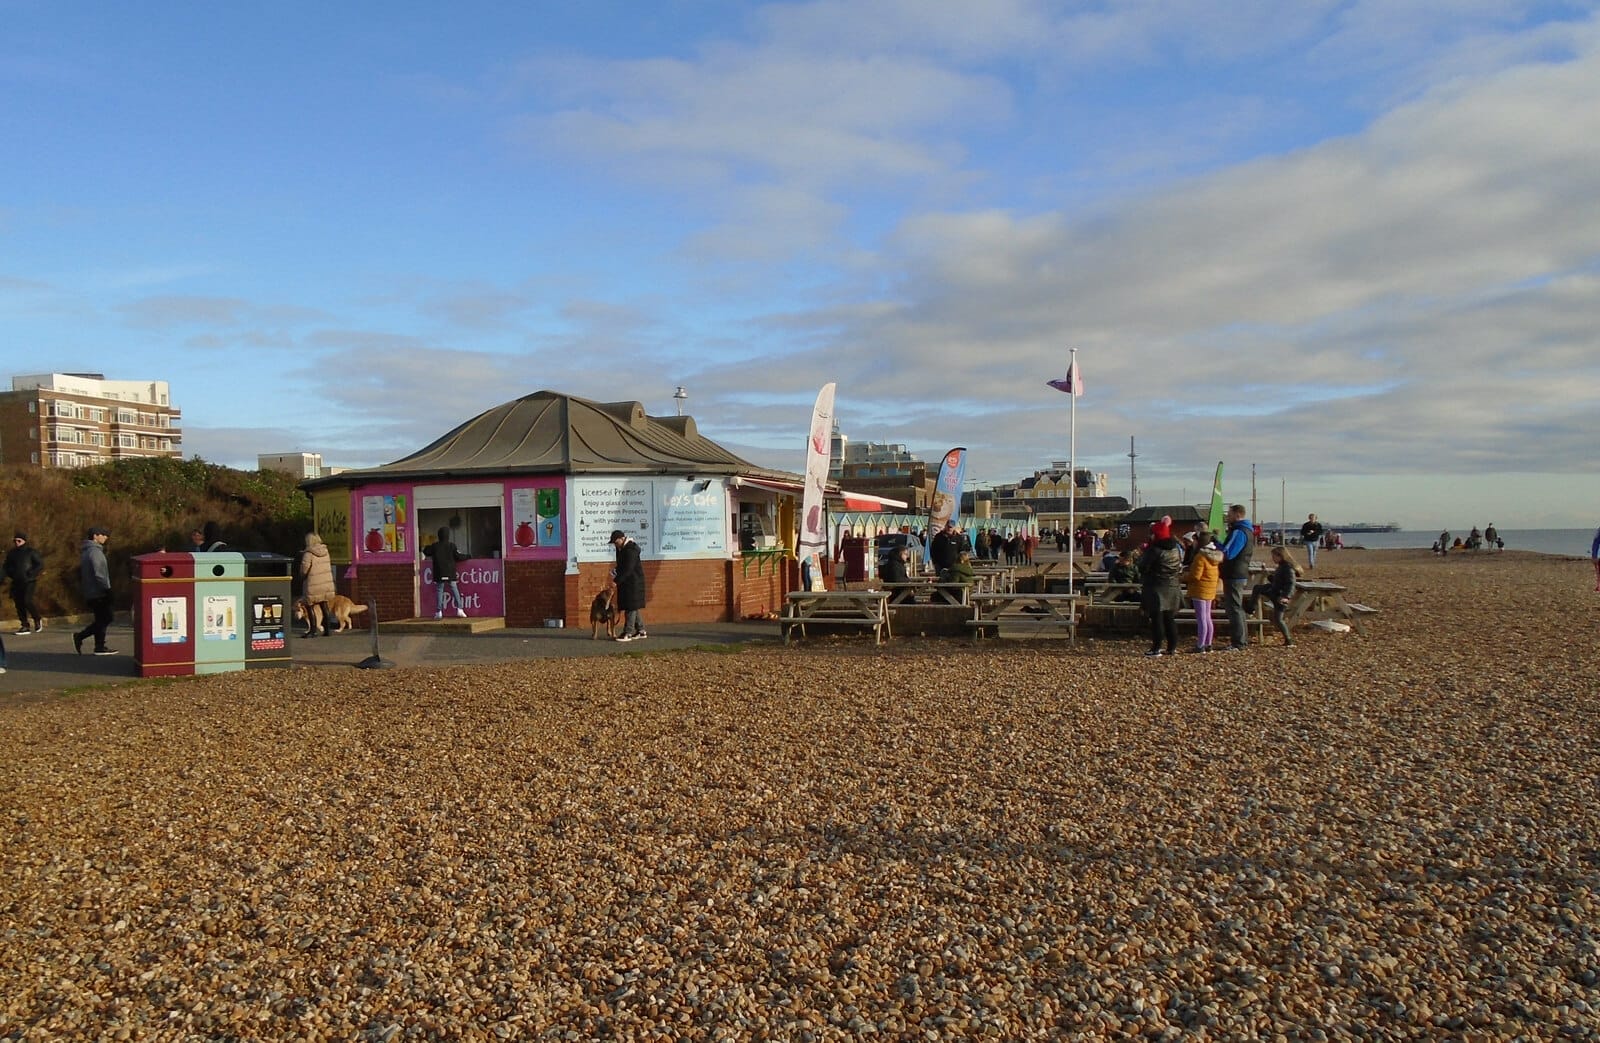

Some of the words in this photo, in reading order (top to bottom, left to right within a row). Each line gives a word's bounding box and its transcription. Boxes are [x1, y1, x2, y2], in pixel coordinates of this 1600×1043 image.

[581, 488, 613, 497] Licensed
[614, 488, 646, 497] Premises
[583, 500, 599, 508] Enjoy
[605, 500, 621, 508] glass
